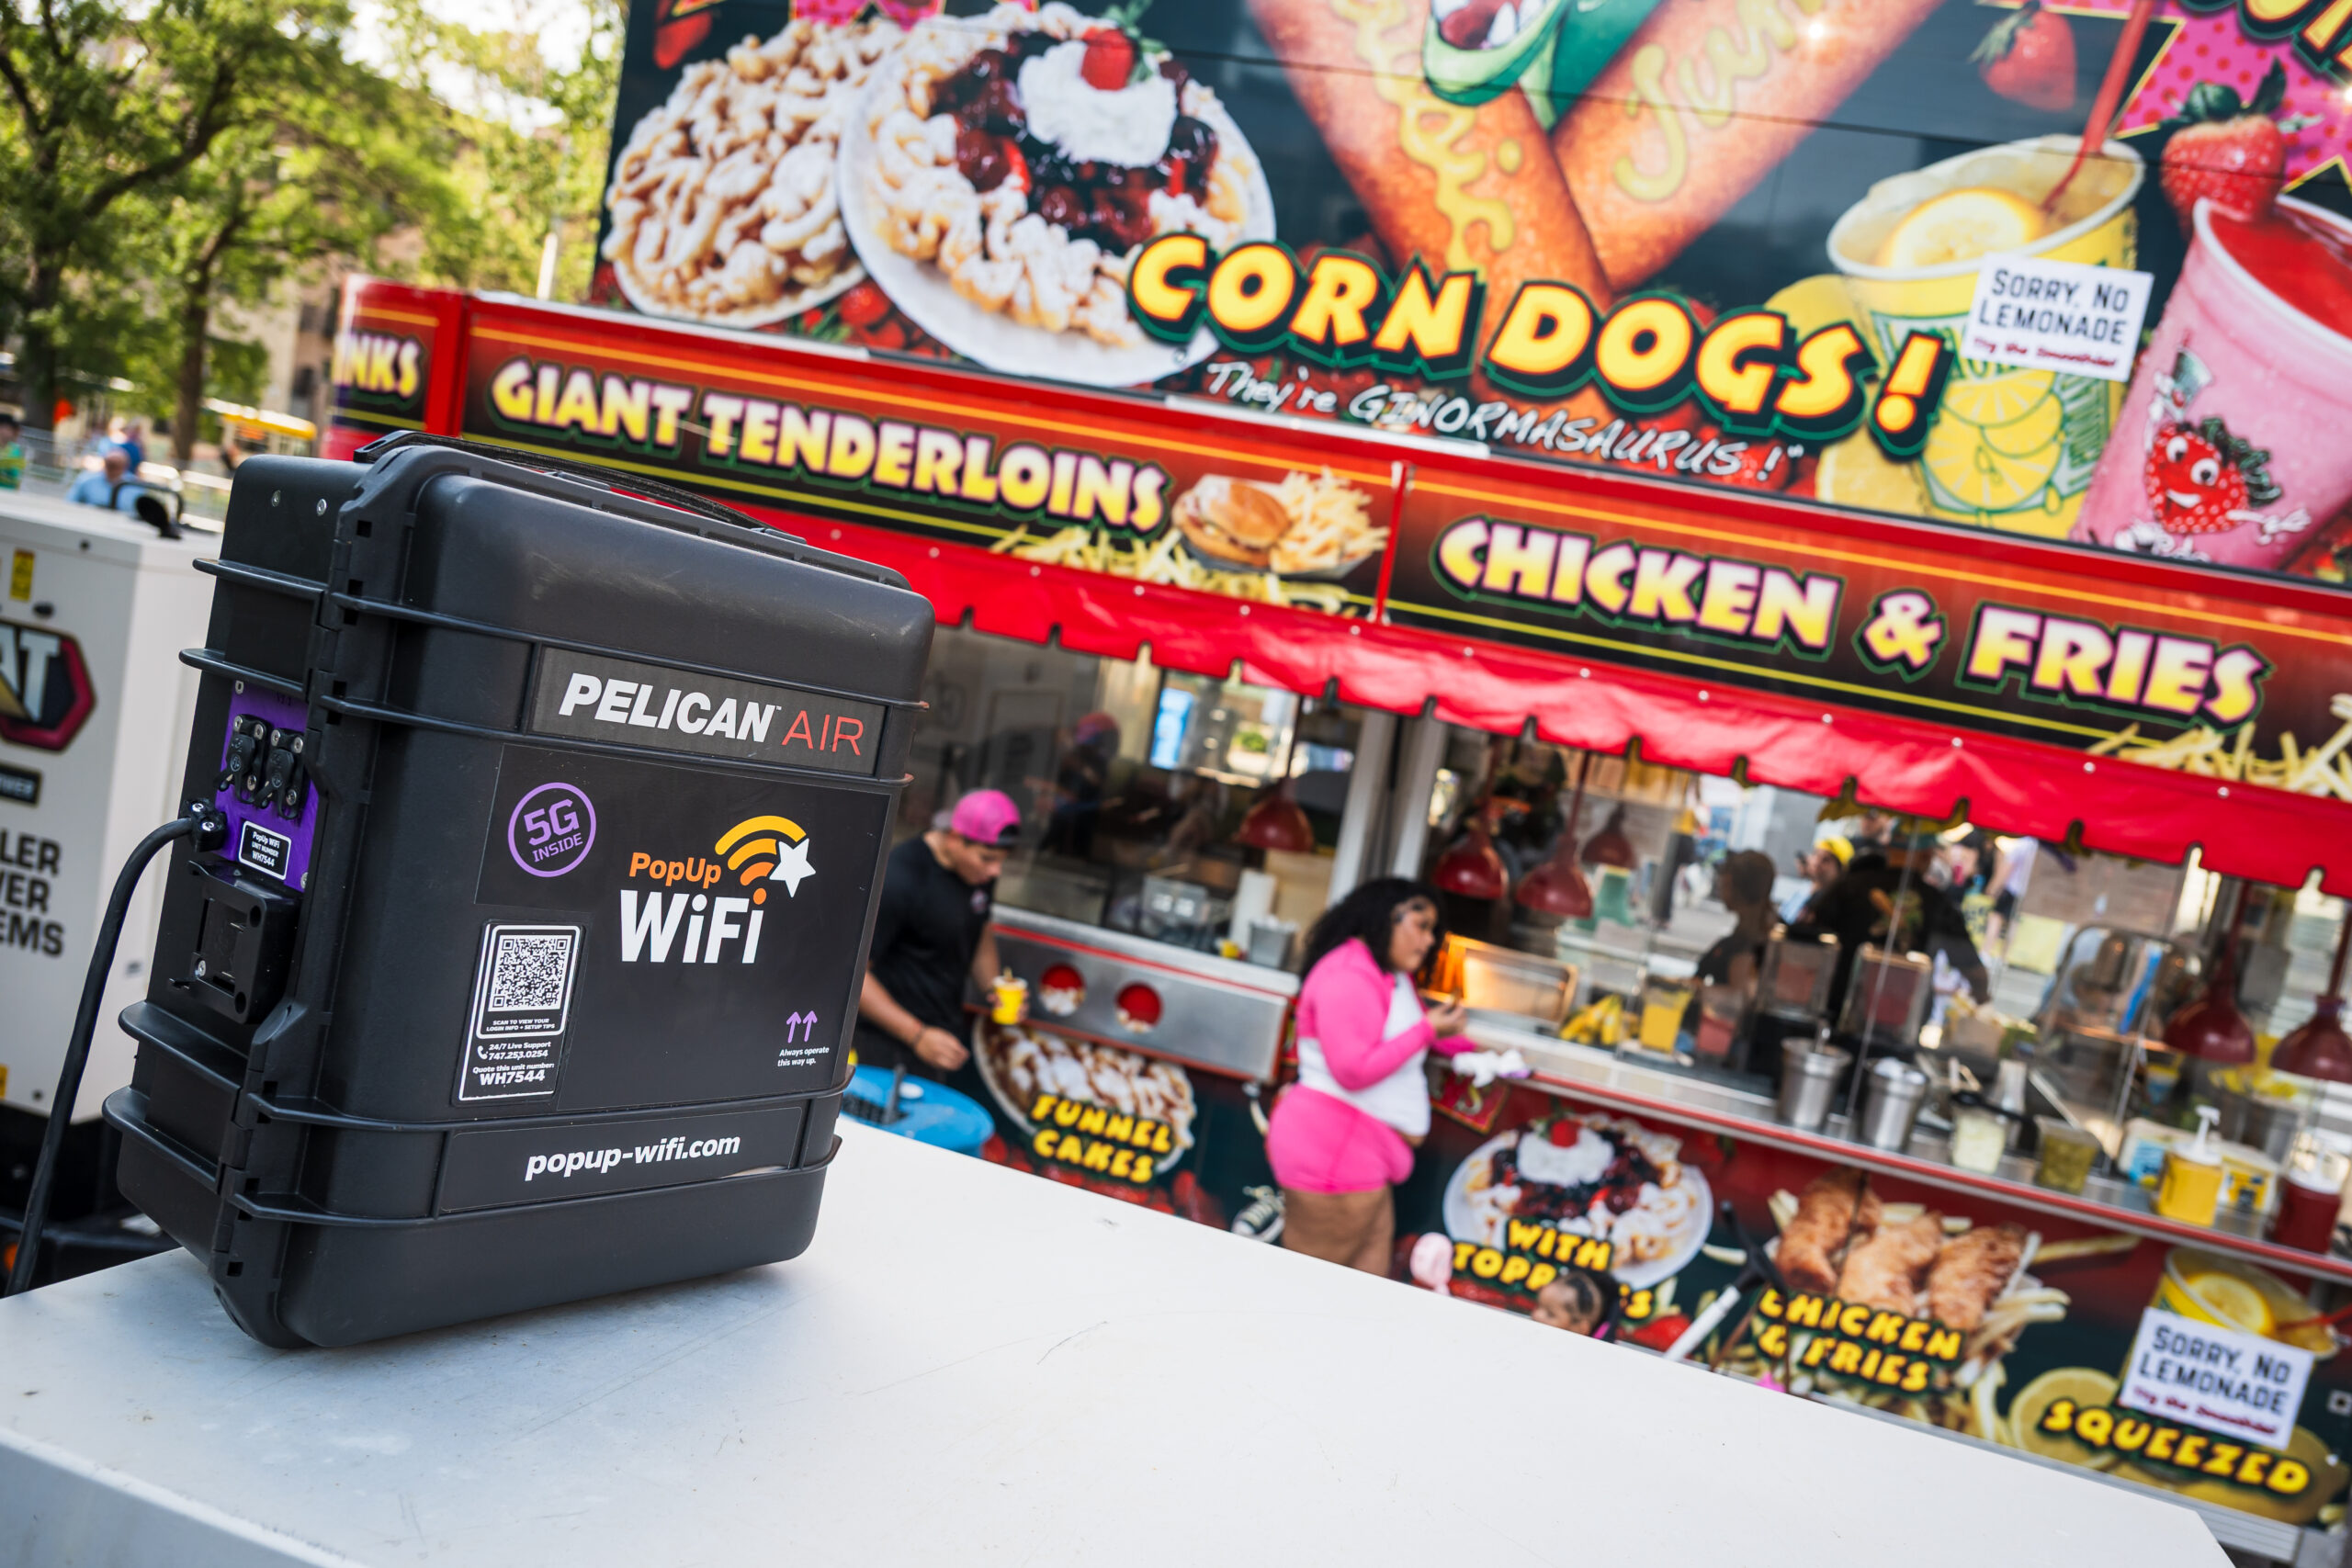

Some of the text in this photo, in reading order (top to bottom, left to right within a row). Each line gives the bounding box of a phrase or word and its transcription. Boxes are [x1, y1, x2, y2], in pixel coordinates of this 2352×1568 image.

[1131, 235, 1476, 358] CORN
[2093, 282, 2130, 312] NO
[1979, 299, 2128, 344] LEMONADE
[1206, 361, 1337, 414] They're
[491, 355, 1168, 532] GIANT TENDERLOINS
[1438, 518, 2267, 724] CHICKEN & FRIES
[781, 710, 865, 756] AIR
[524, 798, 580, 846] 5G
[252, 851, 275, 867] WH7544
[532, 832, 583, 863] INSIDE
[628, 852, 721, 889] PopUp
[0, 869, 50, 916] ER
[620, 887, 767, 964] WiFi
[473, 1066, 495, 1075] Quote
[496, 1064, 510, 1072] this
[526, 1063, 554, 1071] number:
[488, 1050, 548, 1061] 747.253.0254
[489, 1041, 551, 1051] 24/7 Live Support
[779, 1046, 830, 1057] Always operate
[792, 1058, 805, 1066] way
[480, 1069, 545, 1086] WH7544
[1031, 1094, 1171, 1154] FUNNEL
[525, 1136, 741, 1181] popup-wifi.com
[1033, 1129, 1154, 1183] CAKES
[1508, 1218, 1611, 1271] WITH
[1453, 1242, 1654, 1319] TOPPS
[1758, 1288, 1962, 1360] CHICKEN
[1804, 1337, 1930, 1392] FRIES
[2139, 1351, 2288, 1415] LEMONADE
[2254, 1352, 2291, 1384] NO
[2043, 1401, 2312, 1495] SQUEEZED
